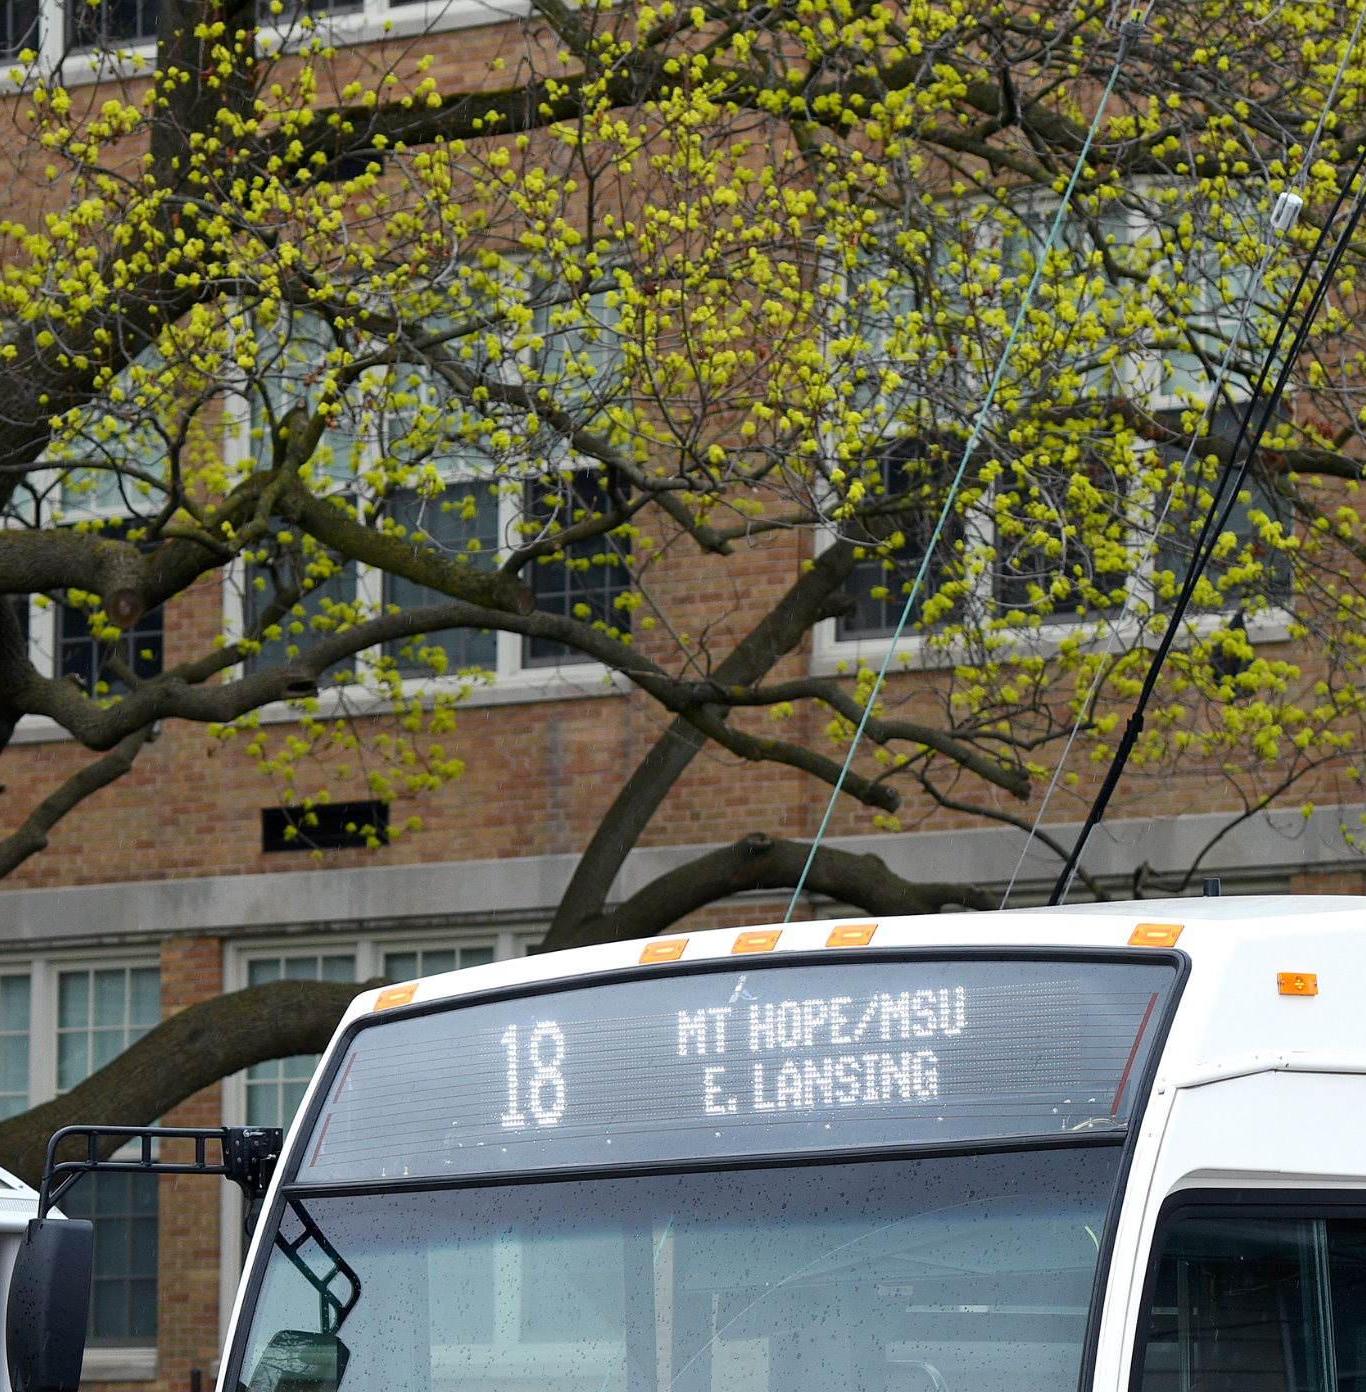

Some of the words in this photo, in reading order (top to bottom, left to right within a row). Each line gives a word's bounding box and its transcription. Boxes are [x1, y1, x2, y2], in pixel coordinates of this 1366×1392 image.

[678, 1006, 732, 1056] MT
[750, 985, 966, 1050] HOPE/MSU
[500, 1020, 565, 1128] 18
[753, 1050, 938, 1109] LANSING
